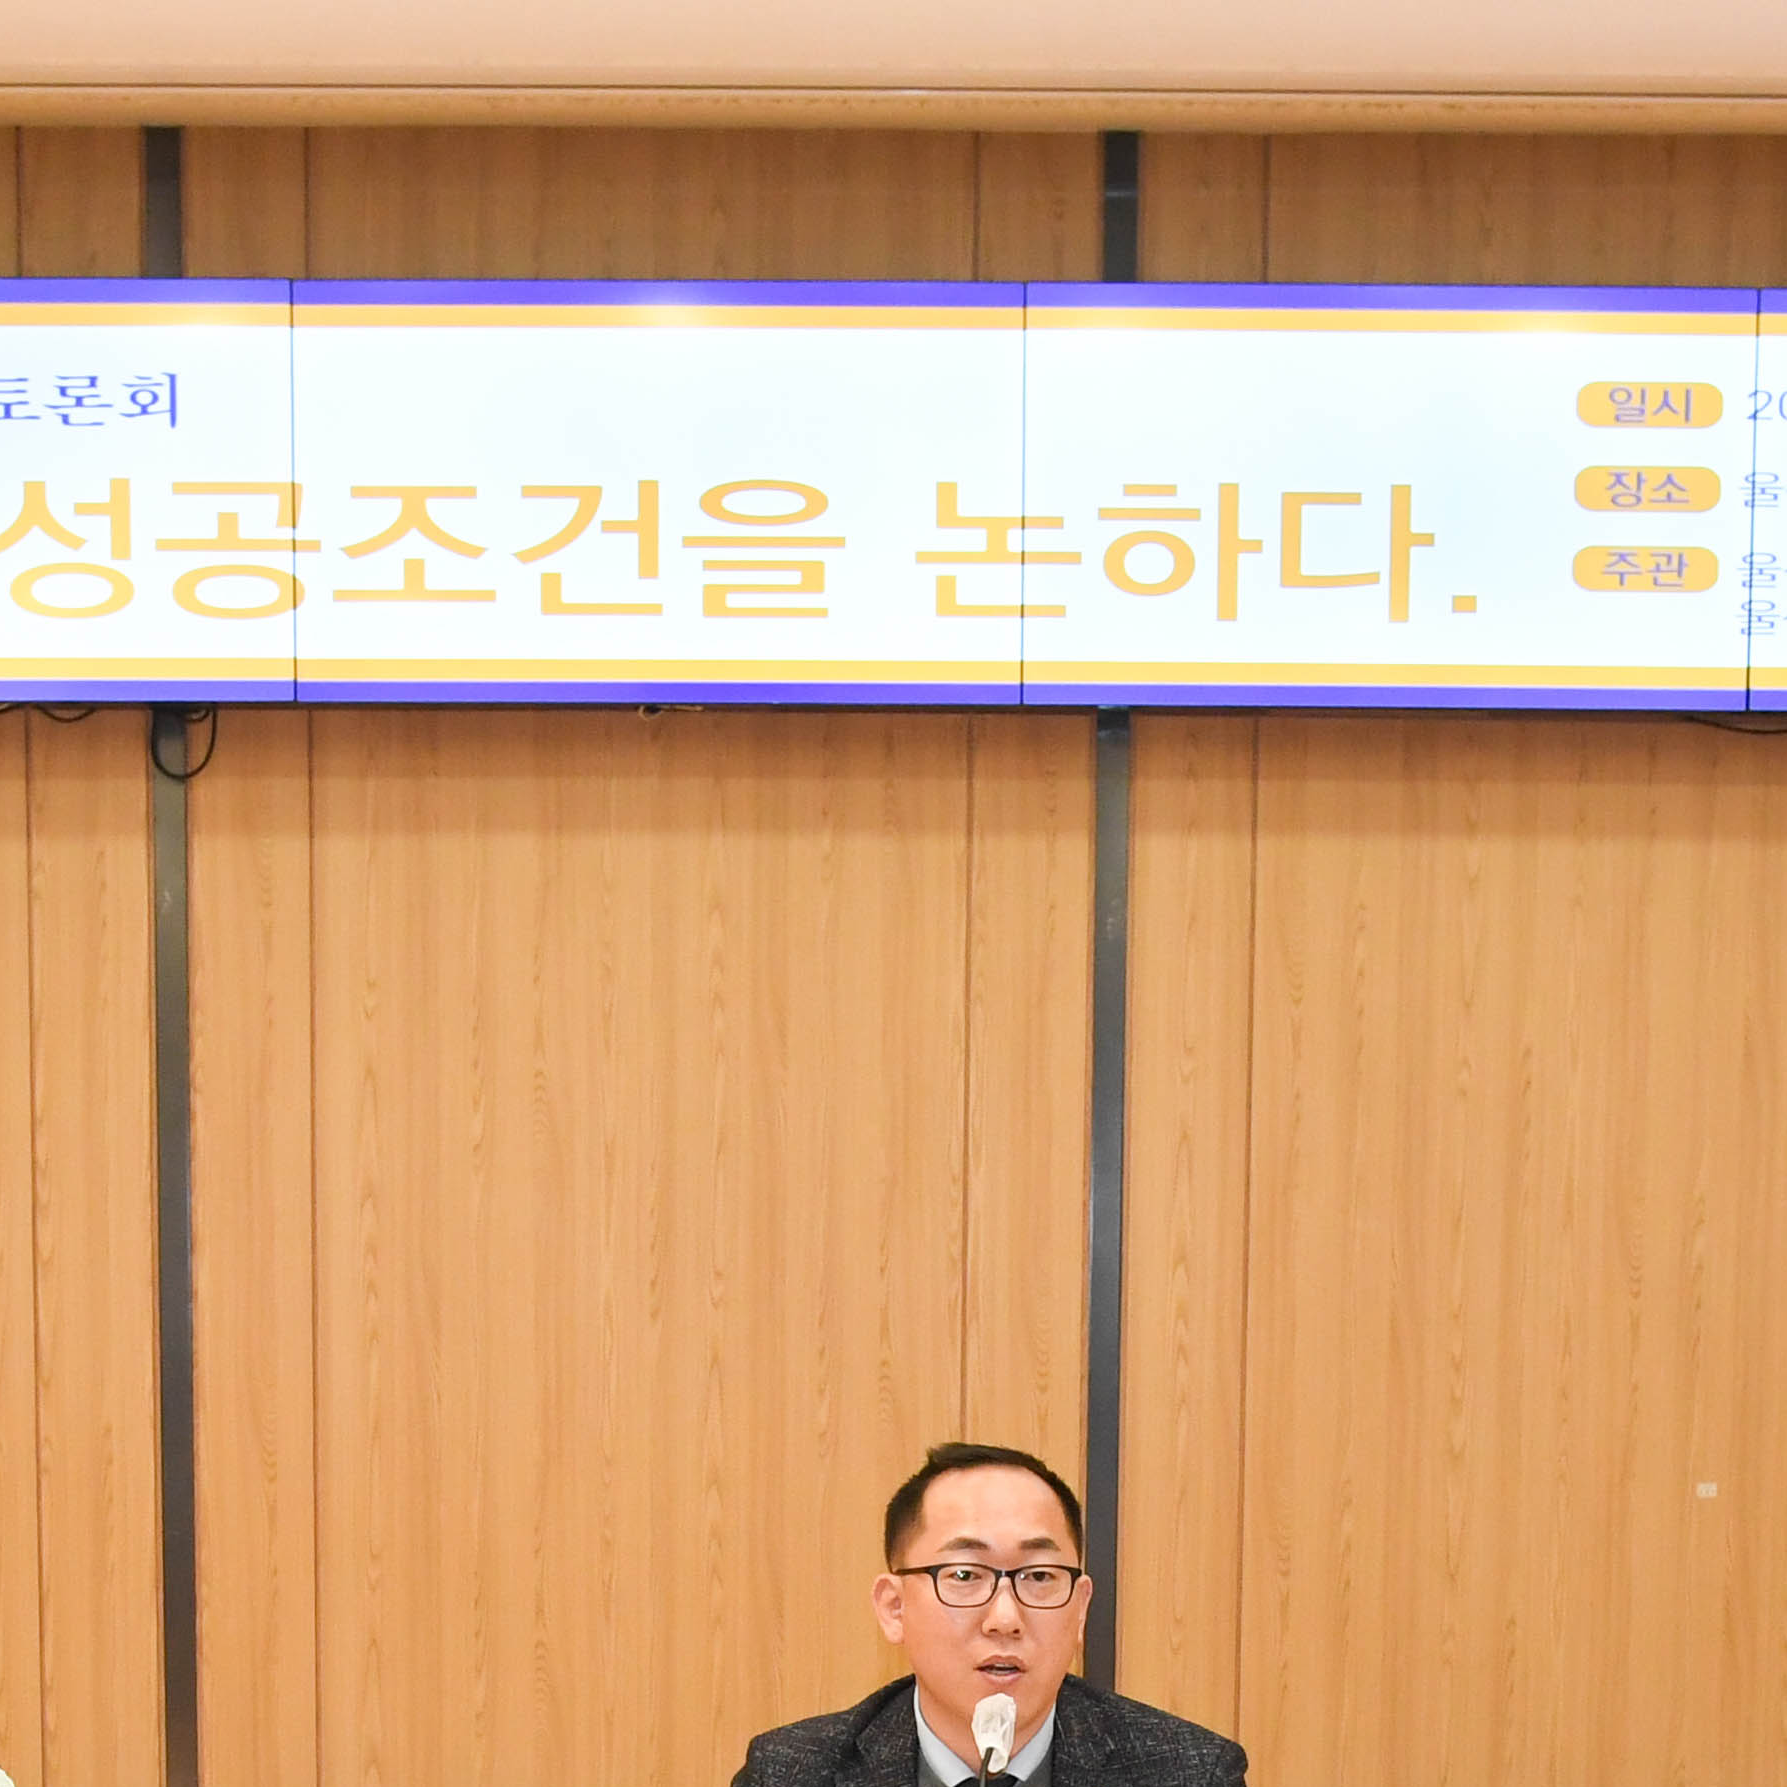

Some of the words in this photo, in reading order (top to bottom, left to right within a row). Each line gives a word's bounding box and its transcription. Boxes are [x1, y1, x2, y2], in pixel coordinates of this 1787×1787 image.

[1607, 386, 1693, 424] 일시
[1606, 471, 1690, 508] 장소
[916, 480, 1477, 623] 논하다.
[1602, 551, 1687, 587] 주관
